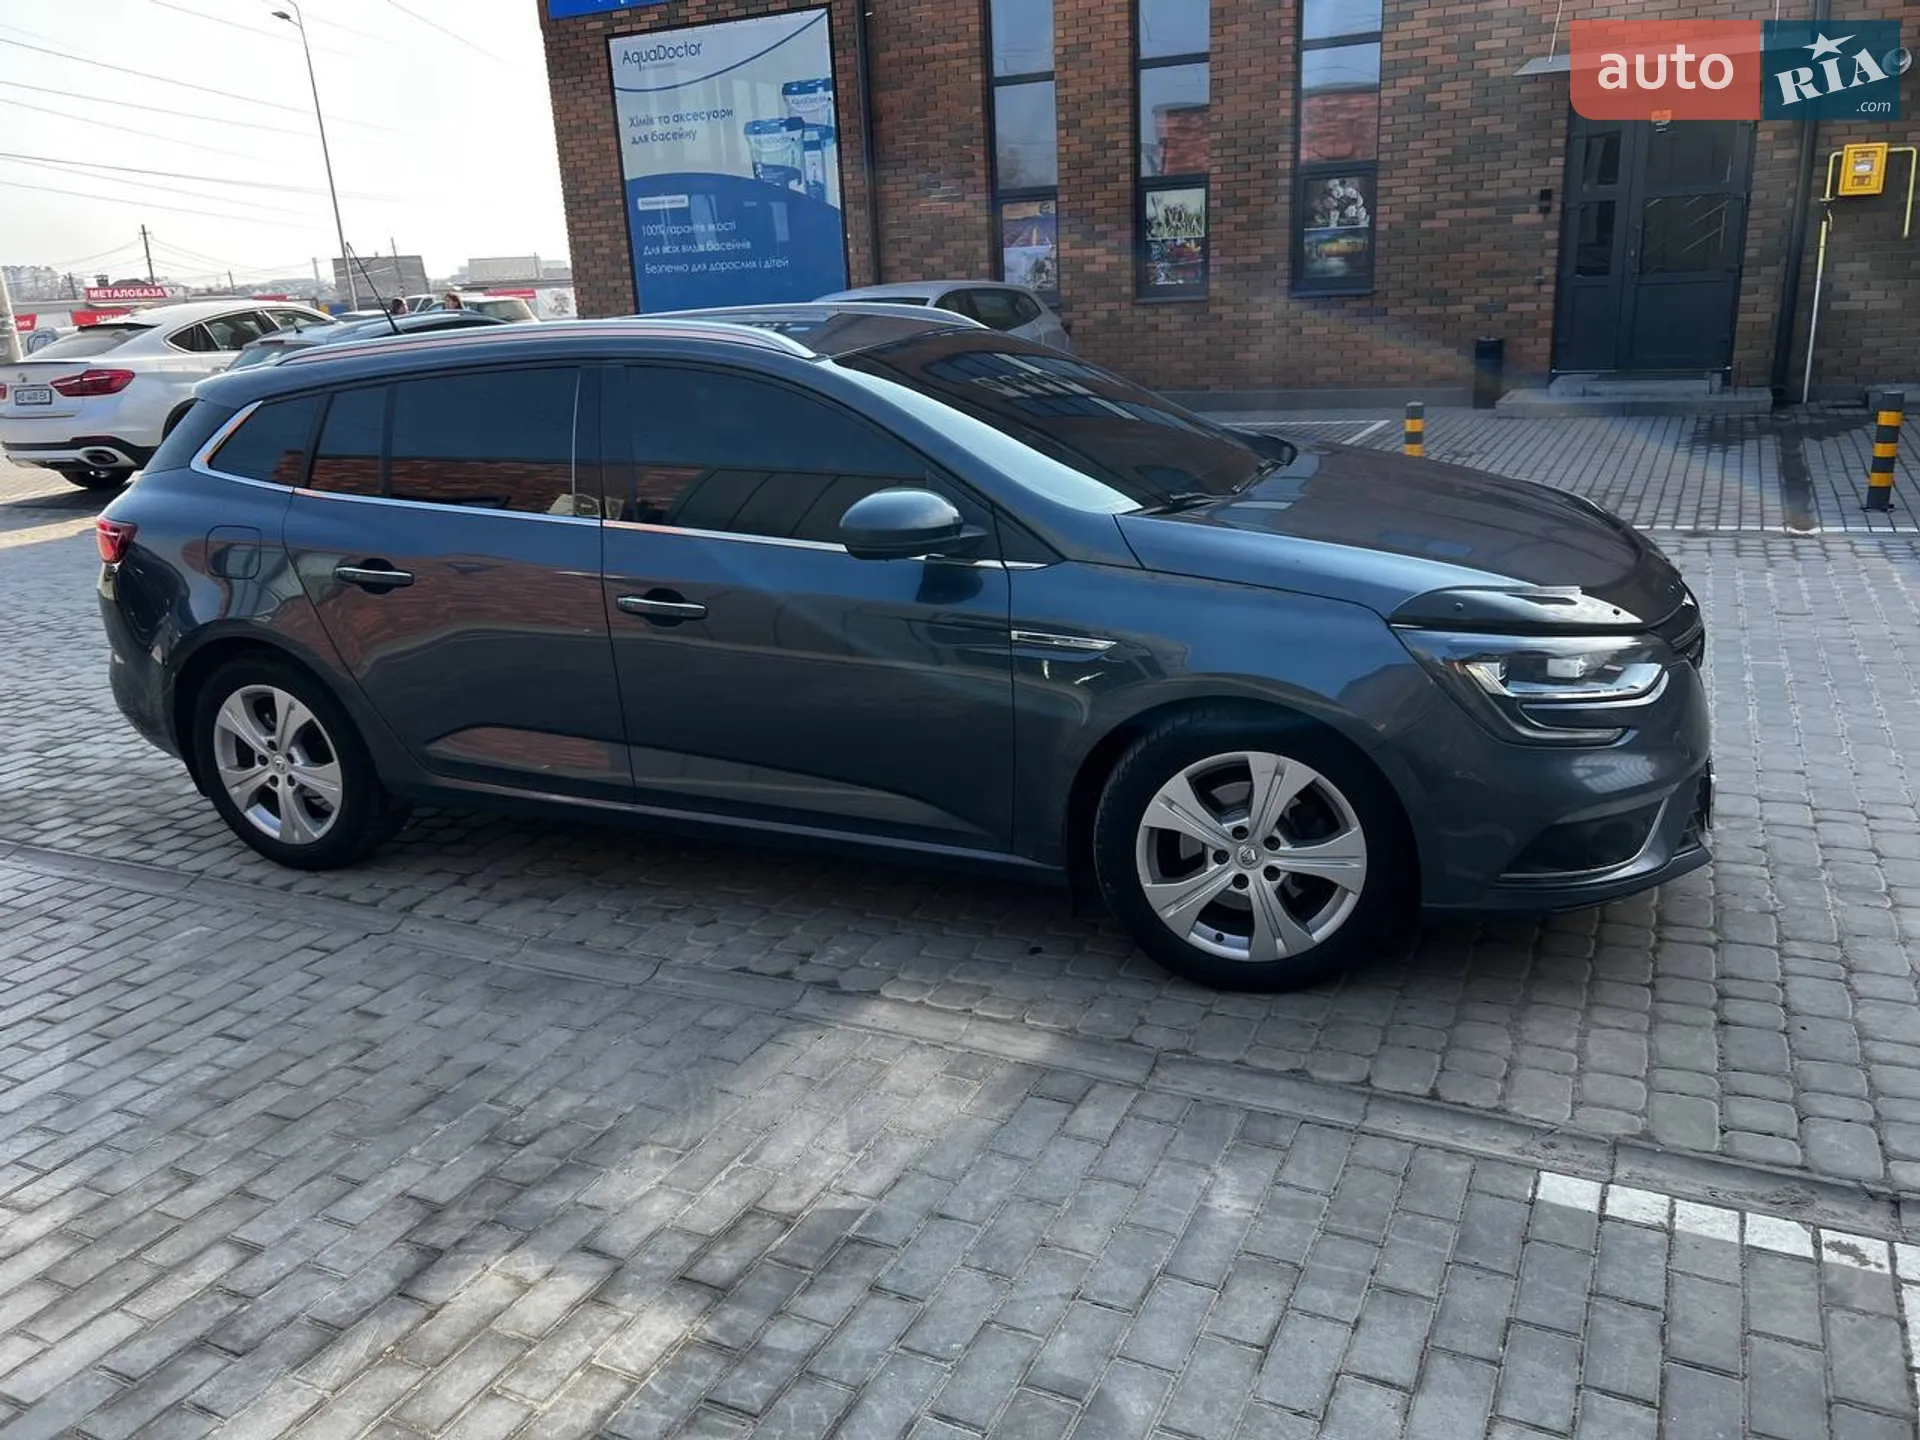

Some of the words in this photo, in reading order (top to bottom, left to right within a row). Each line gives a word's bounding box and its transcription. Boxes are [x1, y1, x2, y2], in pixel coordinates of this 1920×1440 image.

[622, 41, 702, 71] AquaDoctor
[658, 115, 670, 124] та
[672, 108, 734, 124] аксесуари
[631, 133, 649, 145] для
[650, 127, 697, 142] басейну
[642, 224, 665, 237] 100%
[89, 288, 165, 299] МЕТАЛОБАЗА
